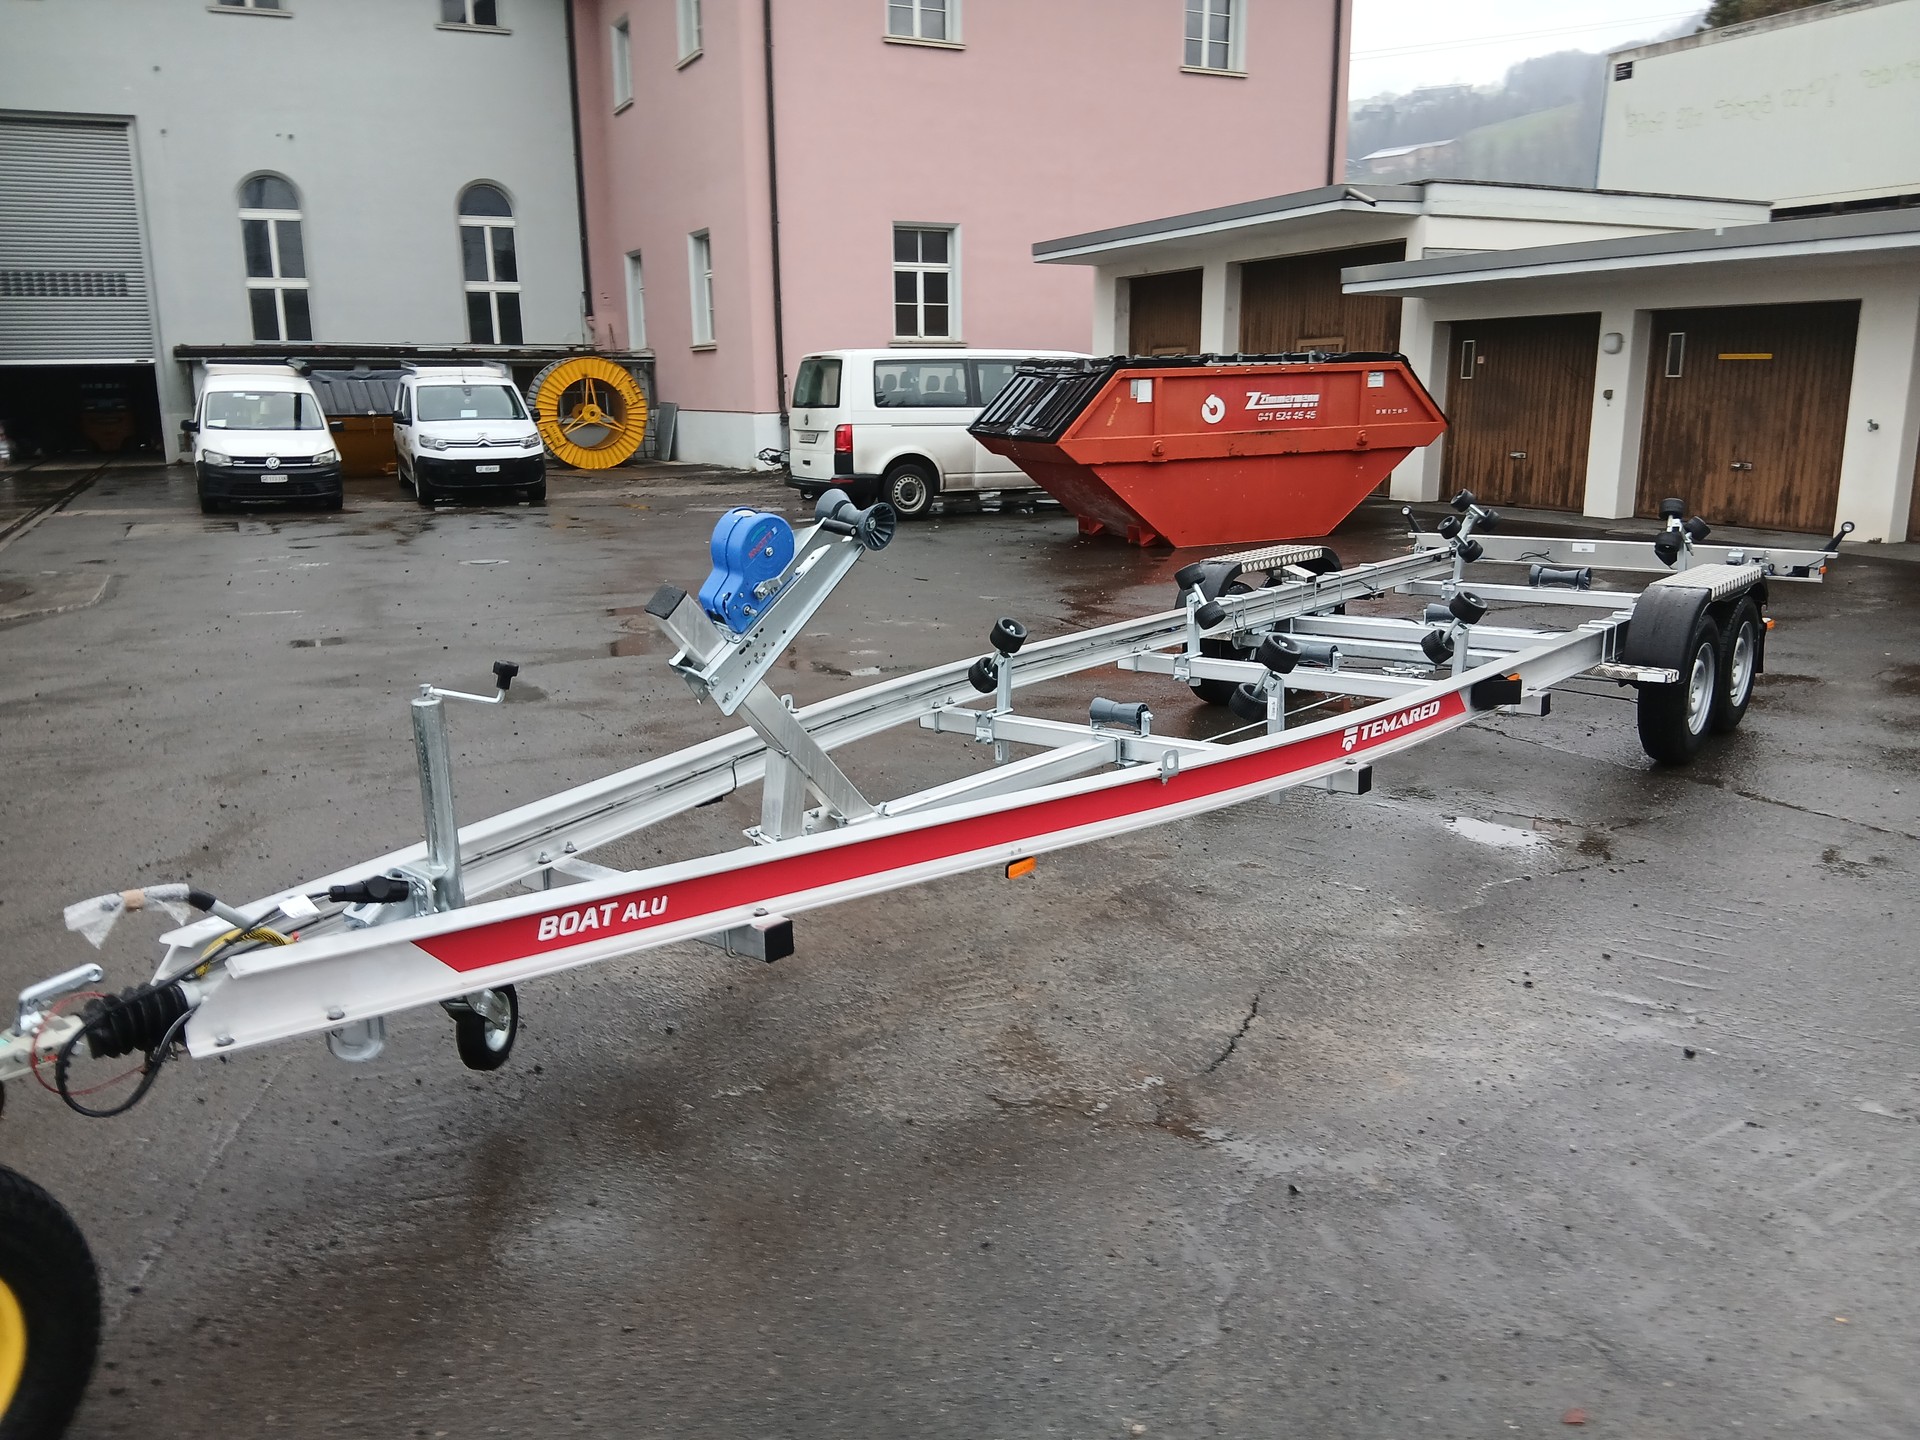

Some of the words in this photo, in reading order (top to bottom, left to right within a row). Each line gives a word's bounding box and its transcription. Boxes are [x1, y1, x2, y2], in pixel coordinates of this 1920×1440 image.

[1360, 700, 1441, 741] TEMARED
[538, 902, 619, 941] BOAT
[621, 895, 669, 923] ALU
